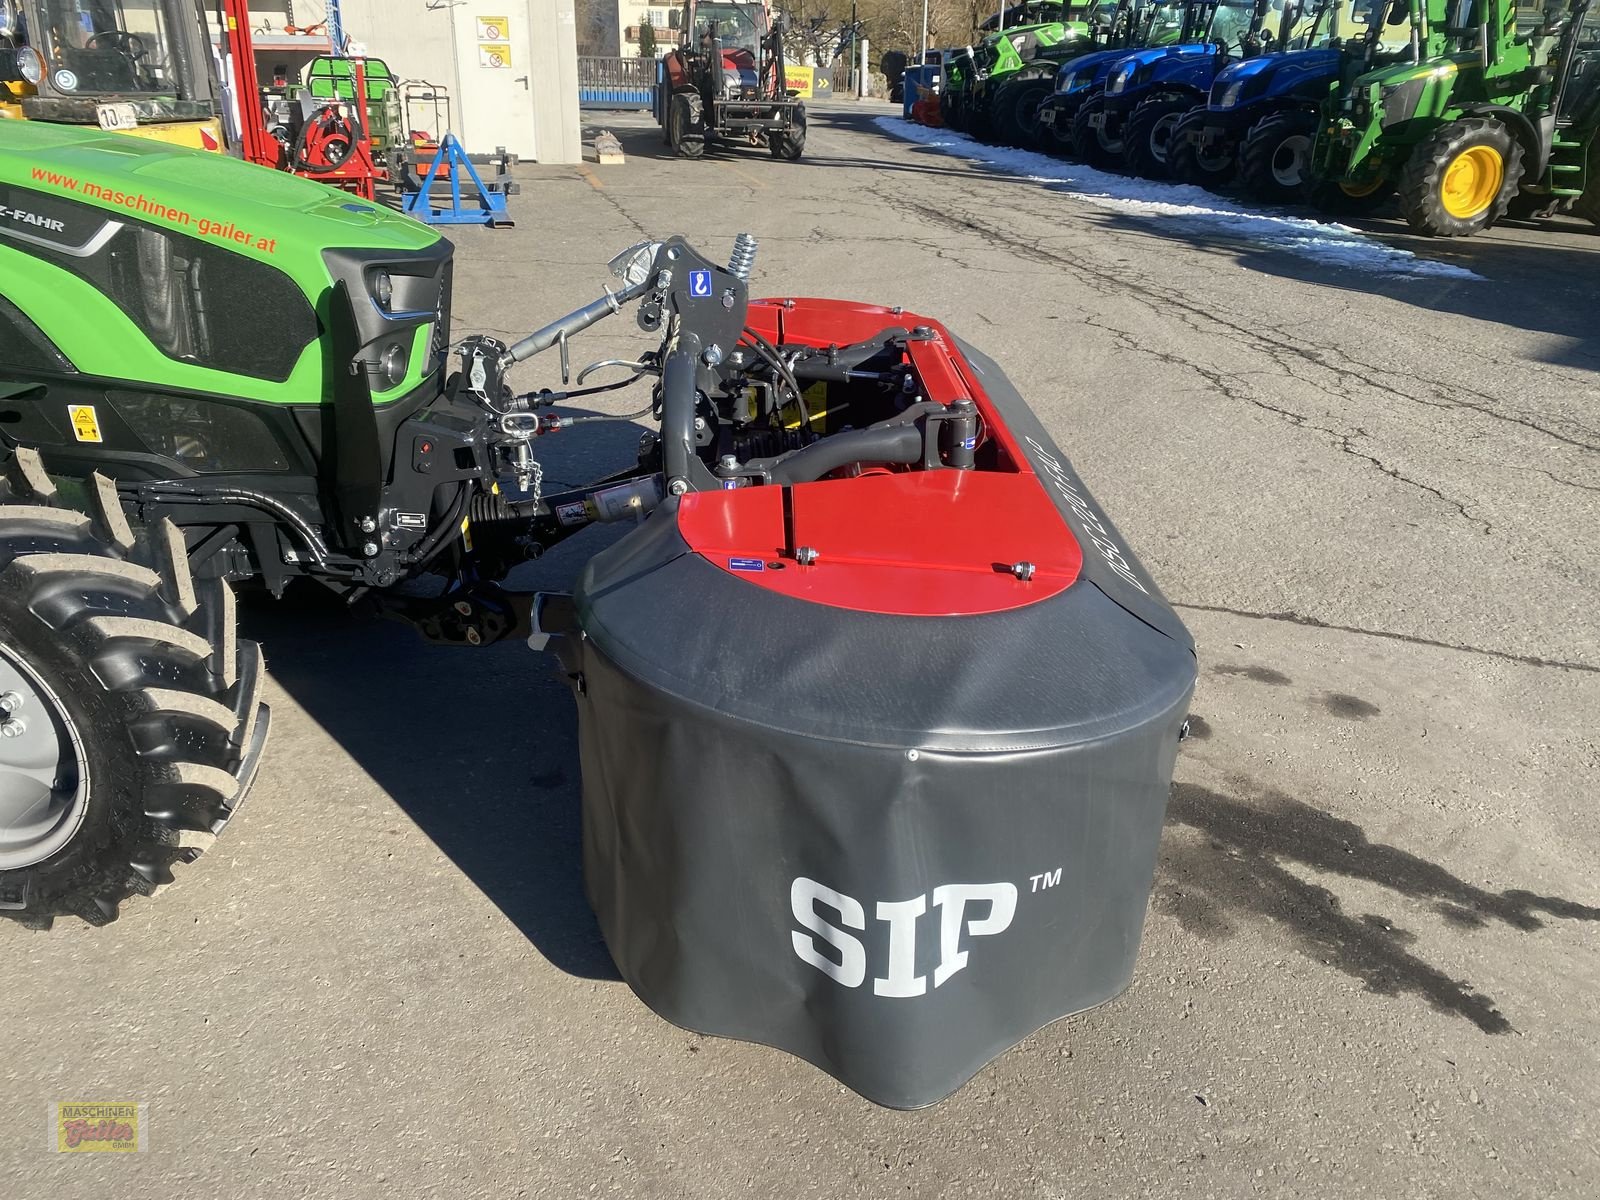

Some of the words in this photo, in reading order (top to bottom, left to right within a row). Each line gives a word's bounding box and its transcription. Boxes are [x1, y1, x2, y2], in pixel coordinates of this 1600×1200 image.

[31, 167, 277, 253] www.maschinen-gailer.at
[791, 877, 1018, 998] SIP
[1029, 868, 1063, 893] TM
